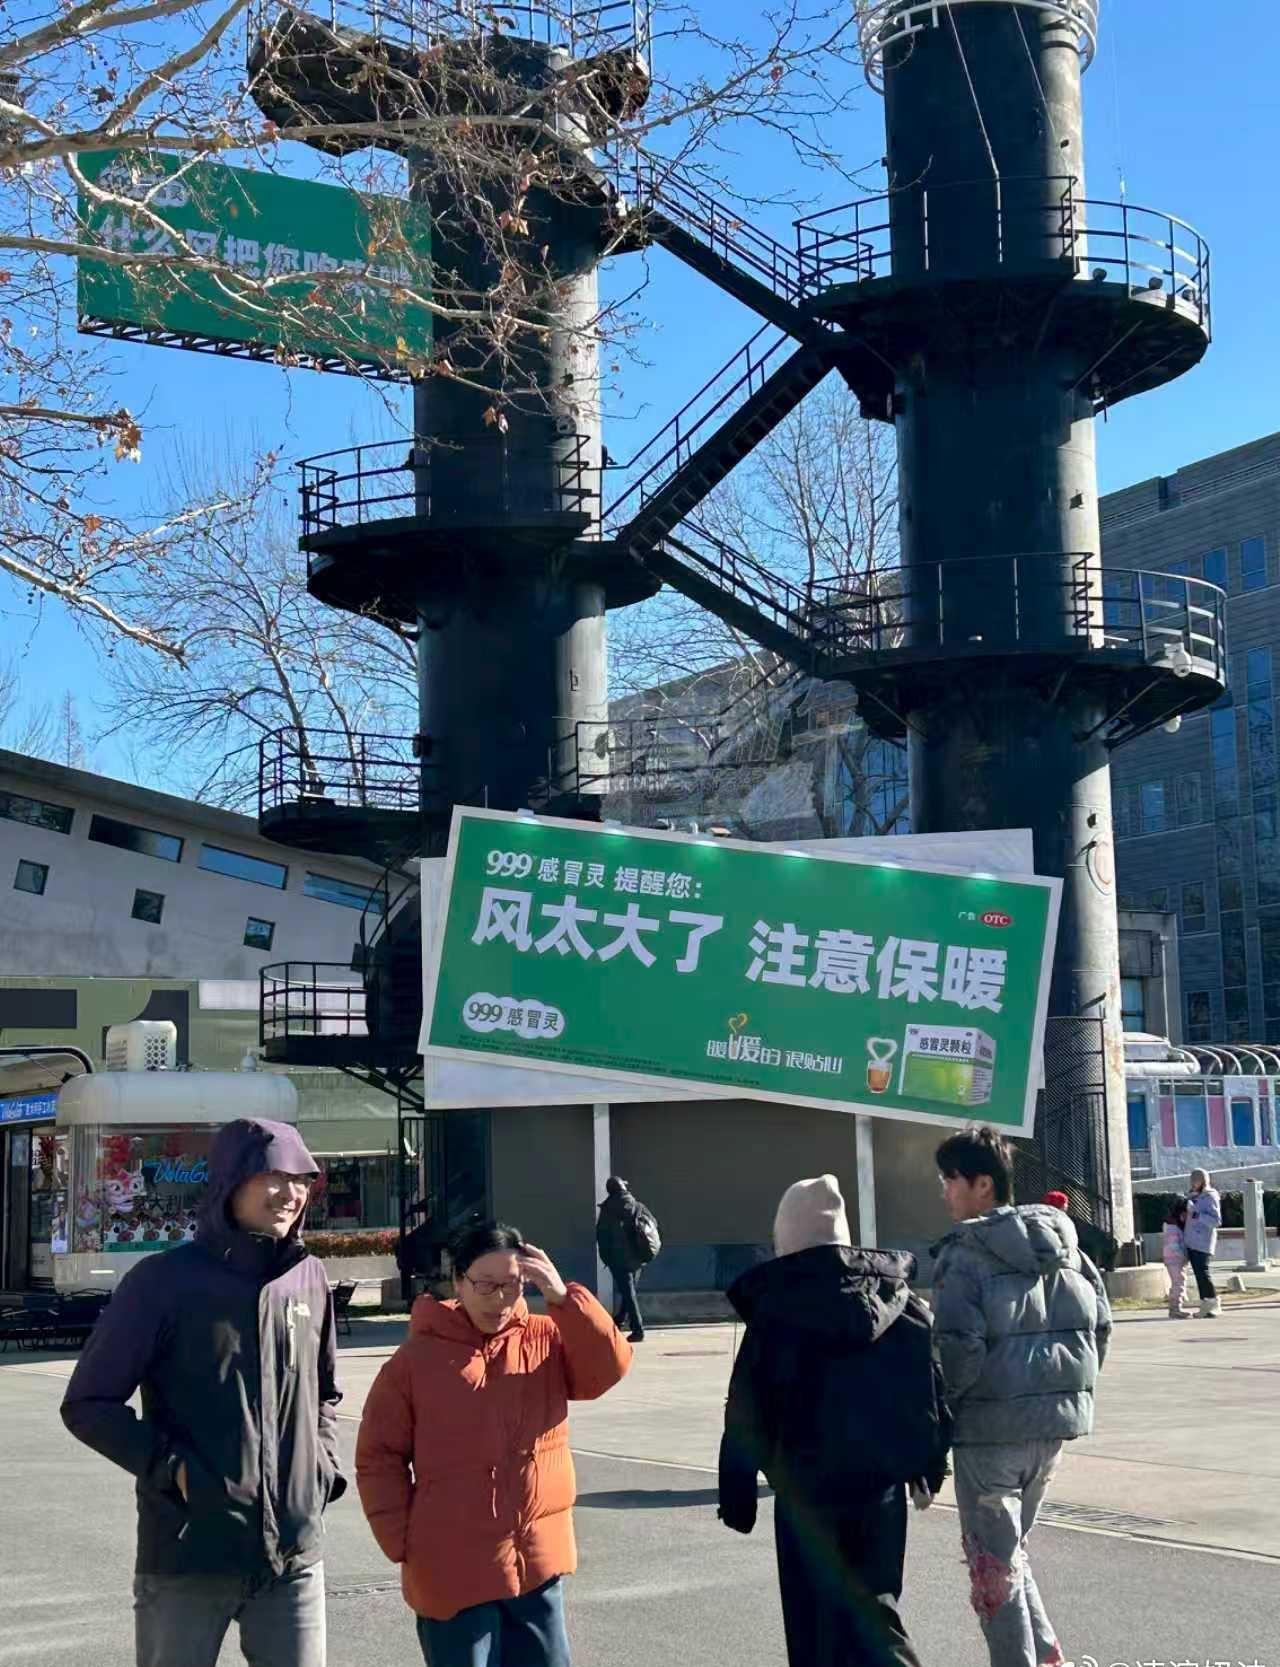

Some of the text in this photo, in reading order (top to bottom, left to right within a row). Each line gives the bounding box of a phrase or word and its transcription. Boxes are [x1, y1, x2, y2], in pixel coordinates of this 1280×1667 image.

[486, 850, 702, 899] 999 感冒灵 提醒您：
[984, 914, 1009, 925] OTC
[471, 886, 1008, 1014] 风太大了 注意保暖
[467, 1001, 558, 1031] 999 感冒灵
